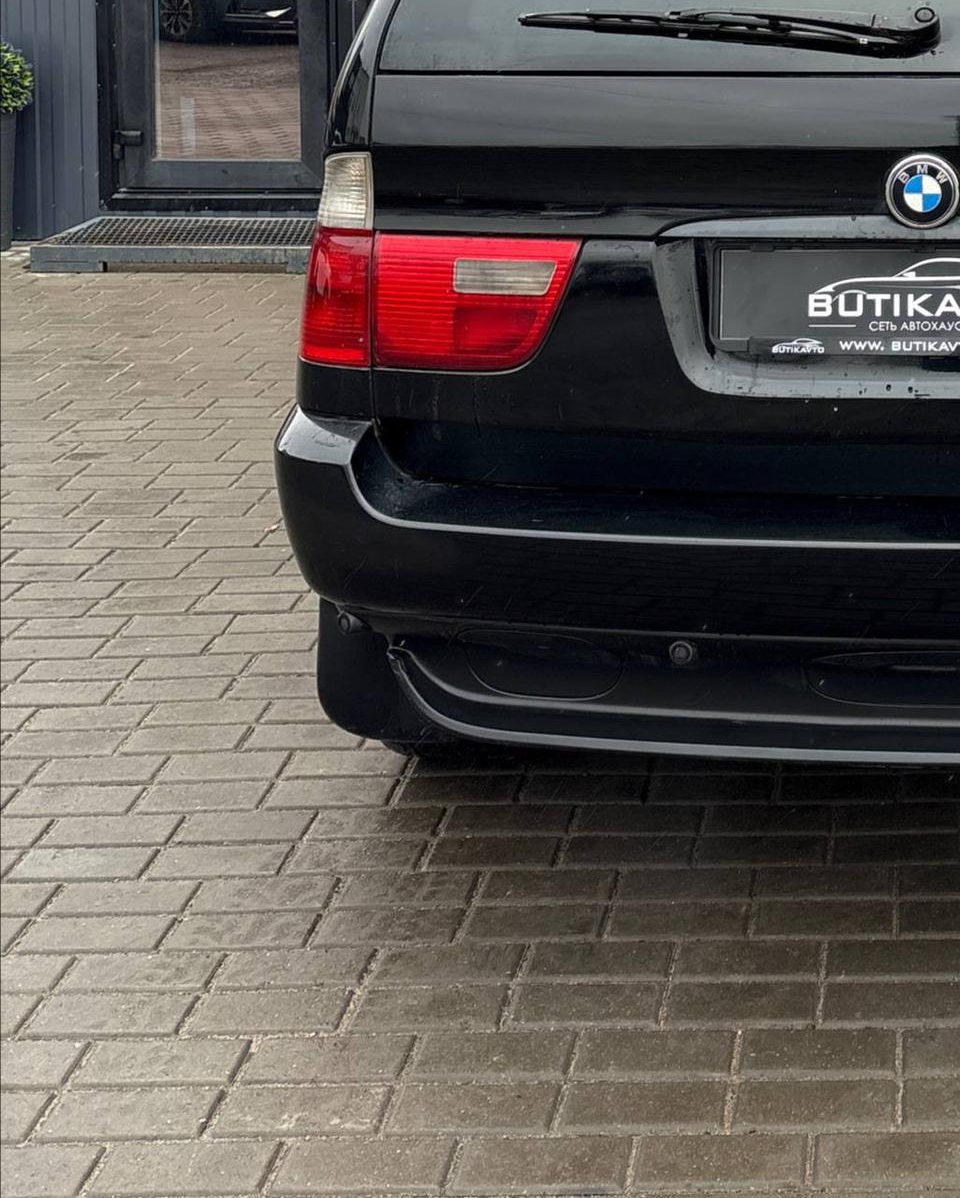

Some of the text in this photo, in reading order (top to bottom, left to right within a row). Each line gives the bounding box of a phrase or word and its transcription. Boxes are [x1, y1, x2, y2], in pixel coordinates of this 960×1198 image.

[898, 164, 949, 185] BMW
[869, 321, 897, 331] СЕТЬ
[772, 345, 825, 353] BUTIKAVTO
